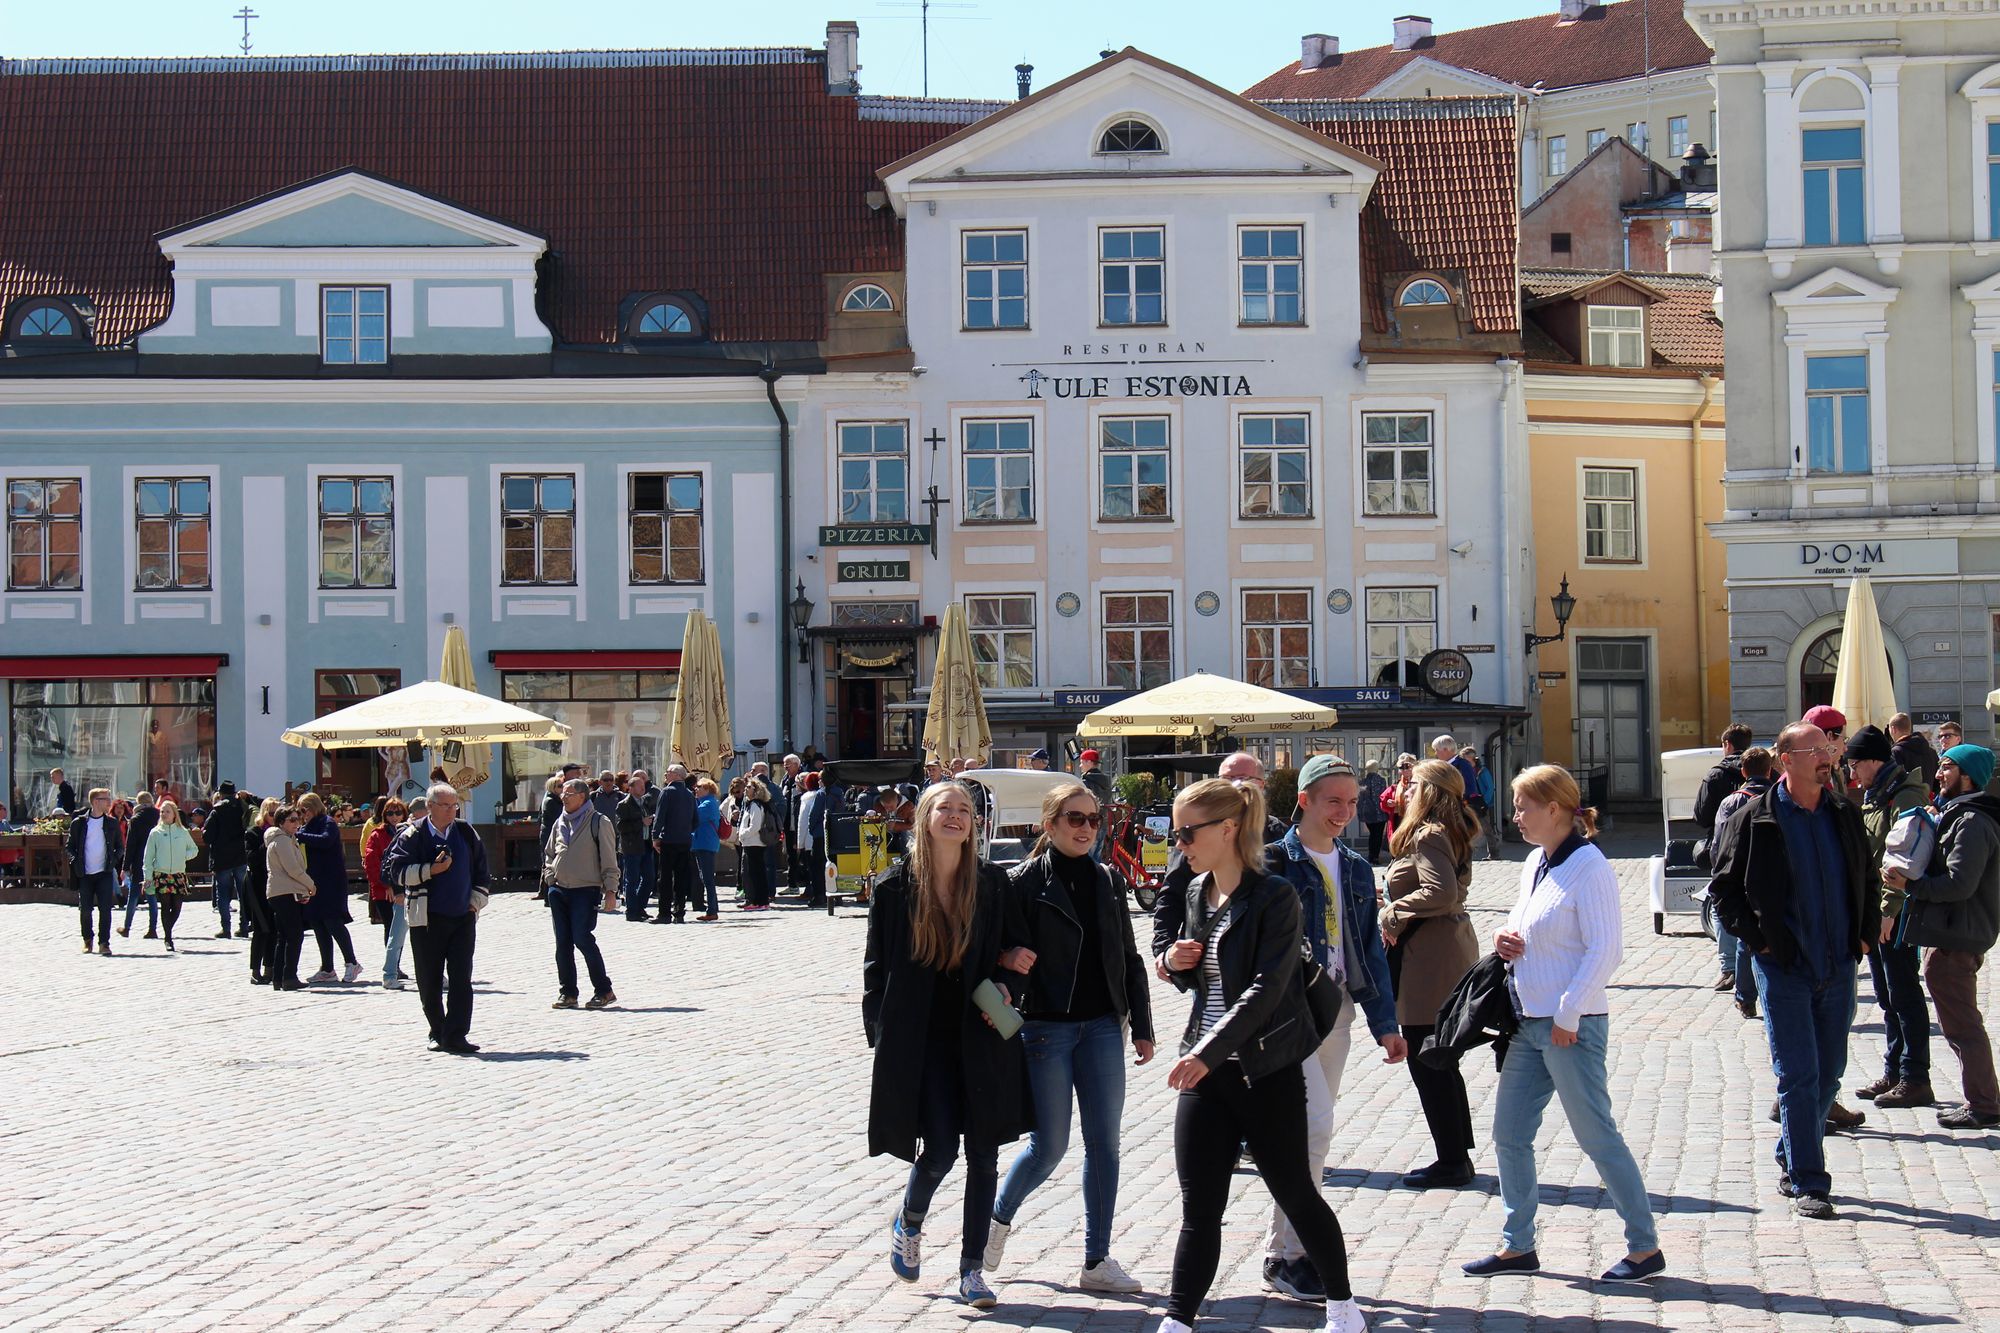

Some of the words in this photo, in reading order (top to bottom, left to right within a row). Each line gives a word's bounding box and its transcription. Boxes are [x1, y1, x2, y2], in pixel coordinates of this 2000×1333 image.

[1063, 342, 1206, 356] RESTORAN
[1124, 375, 1253, 398] ESTONIA
[825, 528, 925, 542] PIZZERIA
[843, 564, 905, 579] GRILL
[1853, 565, 1872, 574] baar
[1744, 647, 1764, 656] Kinga
[1432, 670, 1465, 679] SAKU
[1066, 694, 1100, 704] SAKU
[1356, 691, 1390, 700] SAKU
[1109, 715, 1134, 725] saku
[1169, 714, 1194, 725] saku
[1230, 713, 1255, 724] saku
[1291, 711, 1316, 721] saku
[375, 728, 402, 738] saku
[440, 725, 467, 736] saku
[504, 722, 530, 733] saku
[311, 730, 338, 741] saku
